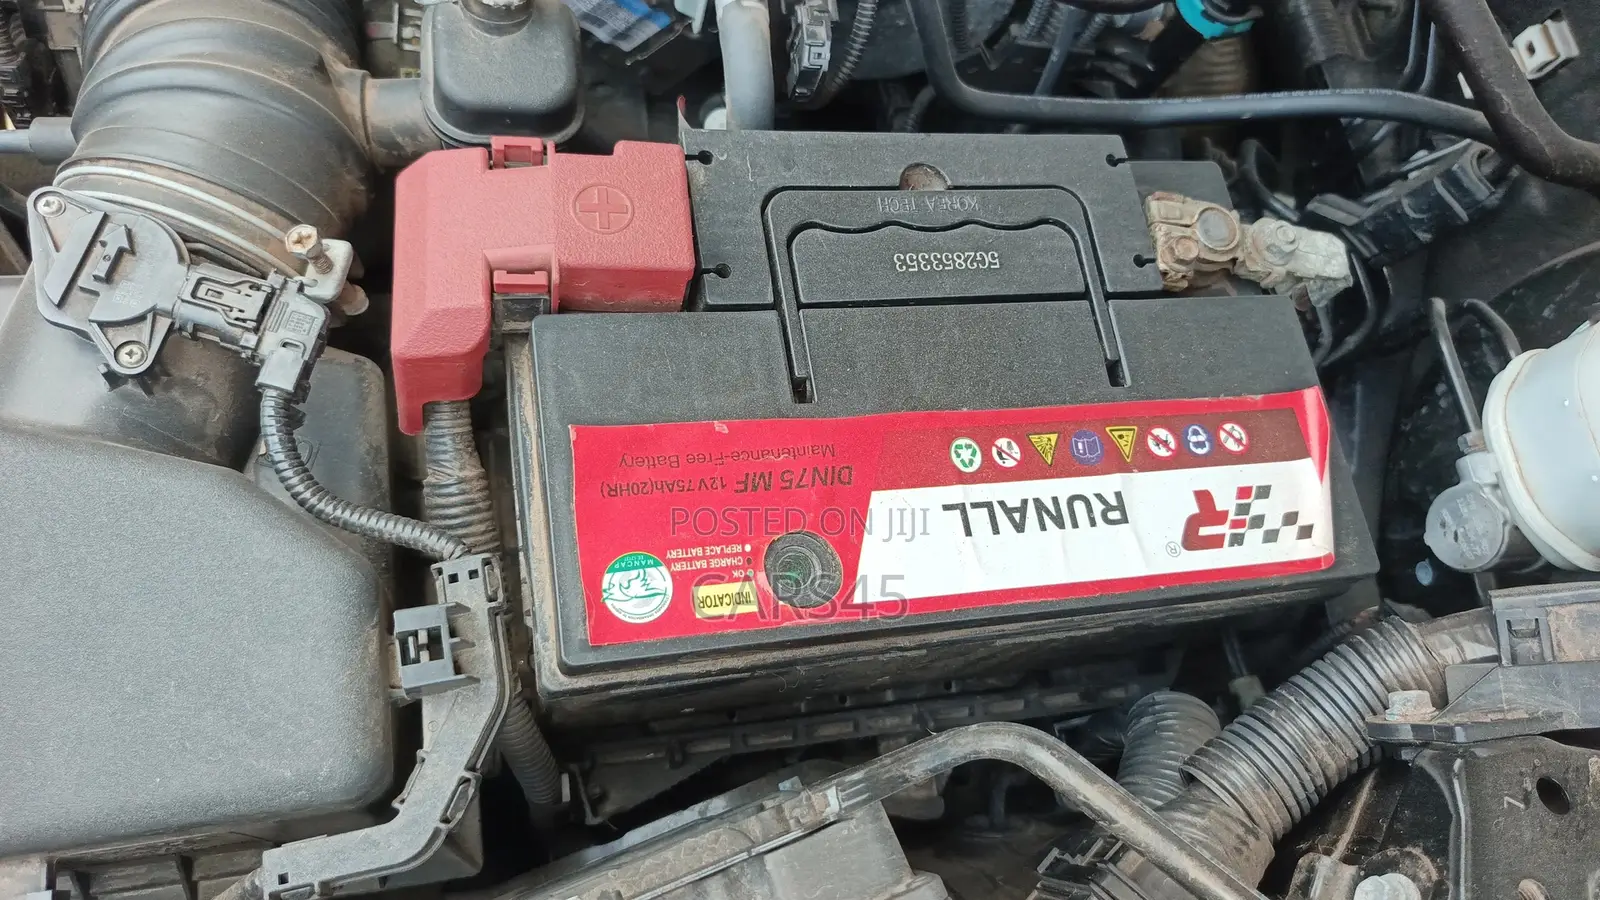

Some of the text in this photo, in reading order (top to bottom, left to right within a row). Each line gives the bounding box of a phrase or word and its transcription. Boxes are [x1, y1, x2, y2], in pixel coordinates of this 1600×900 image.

[893, 251, 1001, 273] 5G2853353
[618, 443, 836, 469] Maintenance-Free Battery
[734, 470, 774, 494] MF
[779, 465, 853, 491] DIN75
[942, 490, 1129, 537] RUNALL
[666, 543, 743, 559] REPLACE BATTERY
[614, 559, 654, 569] MANCAP
[670, 556, 743, 572] CHARGE BATTERY
[732, 570, 745, 578] OK
[697, 592, 752, 609] INDICATOR
